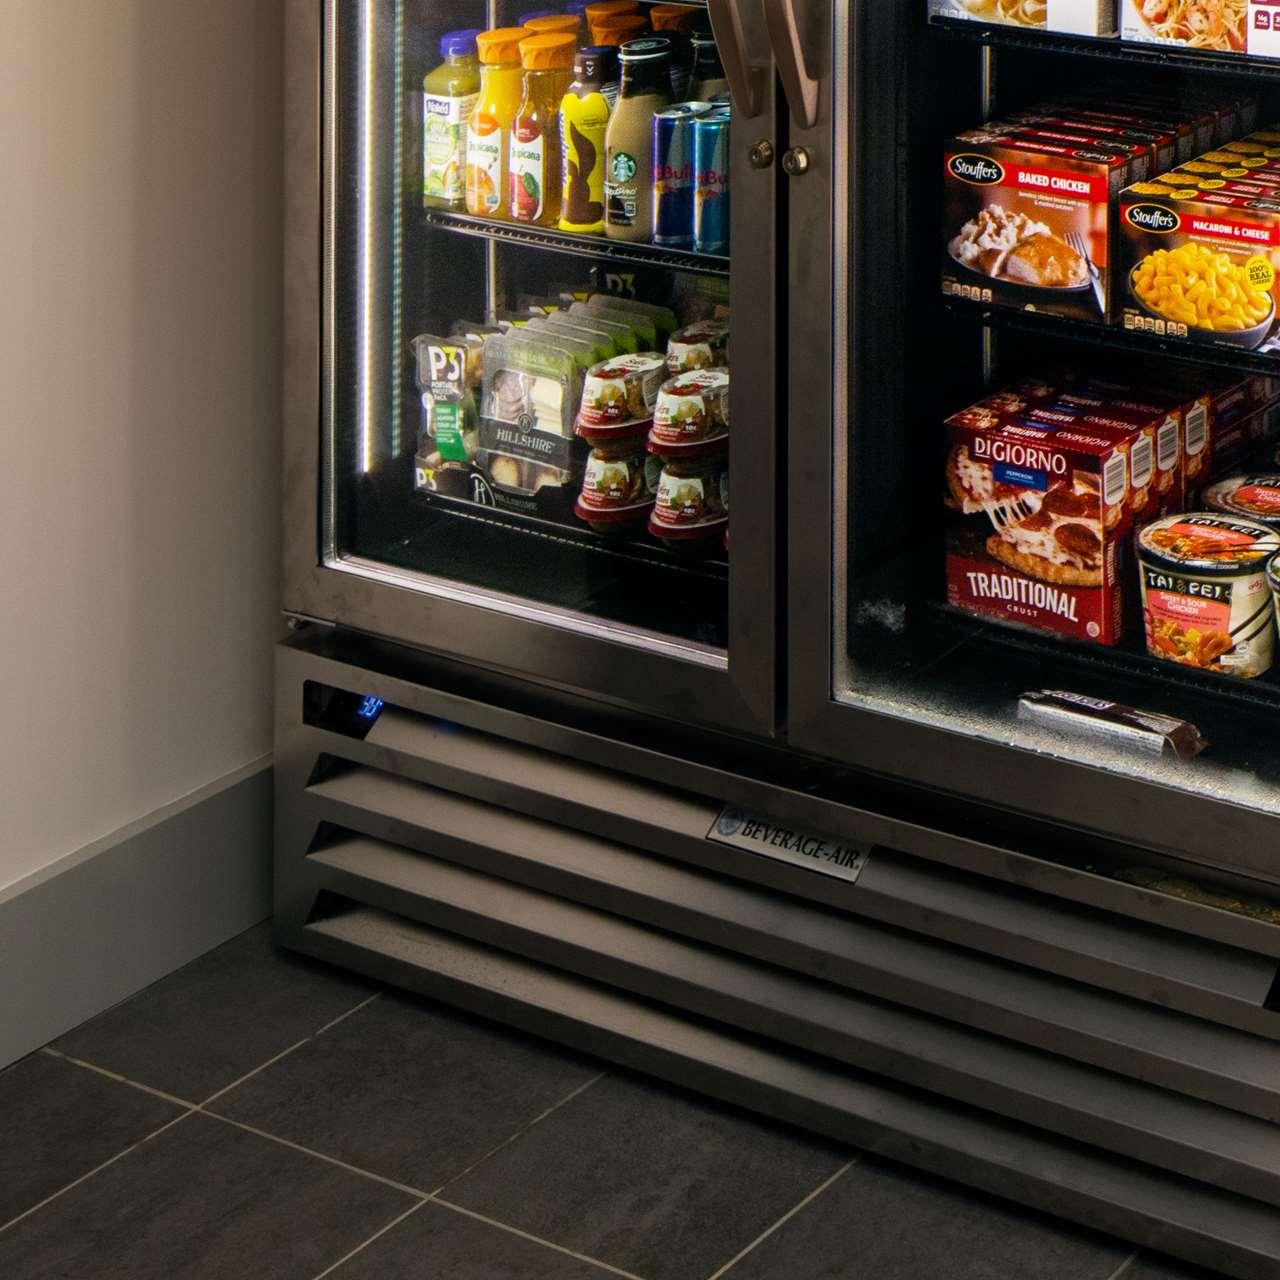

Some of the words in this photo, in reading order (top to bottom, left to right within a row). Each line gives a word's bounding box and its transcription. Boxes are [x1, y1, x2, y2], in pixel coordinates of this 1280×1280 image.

[953, 156, 999, 182] Stouffer's
[1017, 171, 1049, 188] BAKED
[1050, 175, 1091, 194] CHICKEN
[1130, 206, 1175, 230] Stouffer's
[1192, 219, 1233, 236] MACARONI
[1241, 227, 1270, 240] CHEESE
[496, 428, 554, 453] HILLSHIRE
[966, 570, 1080, 624] TRADITIONAL
[1147, 573, 1174, 589] TAI
[1189, 582, 1220, 598] PEI
[1006, 603, 1038, 619] CRUST
